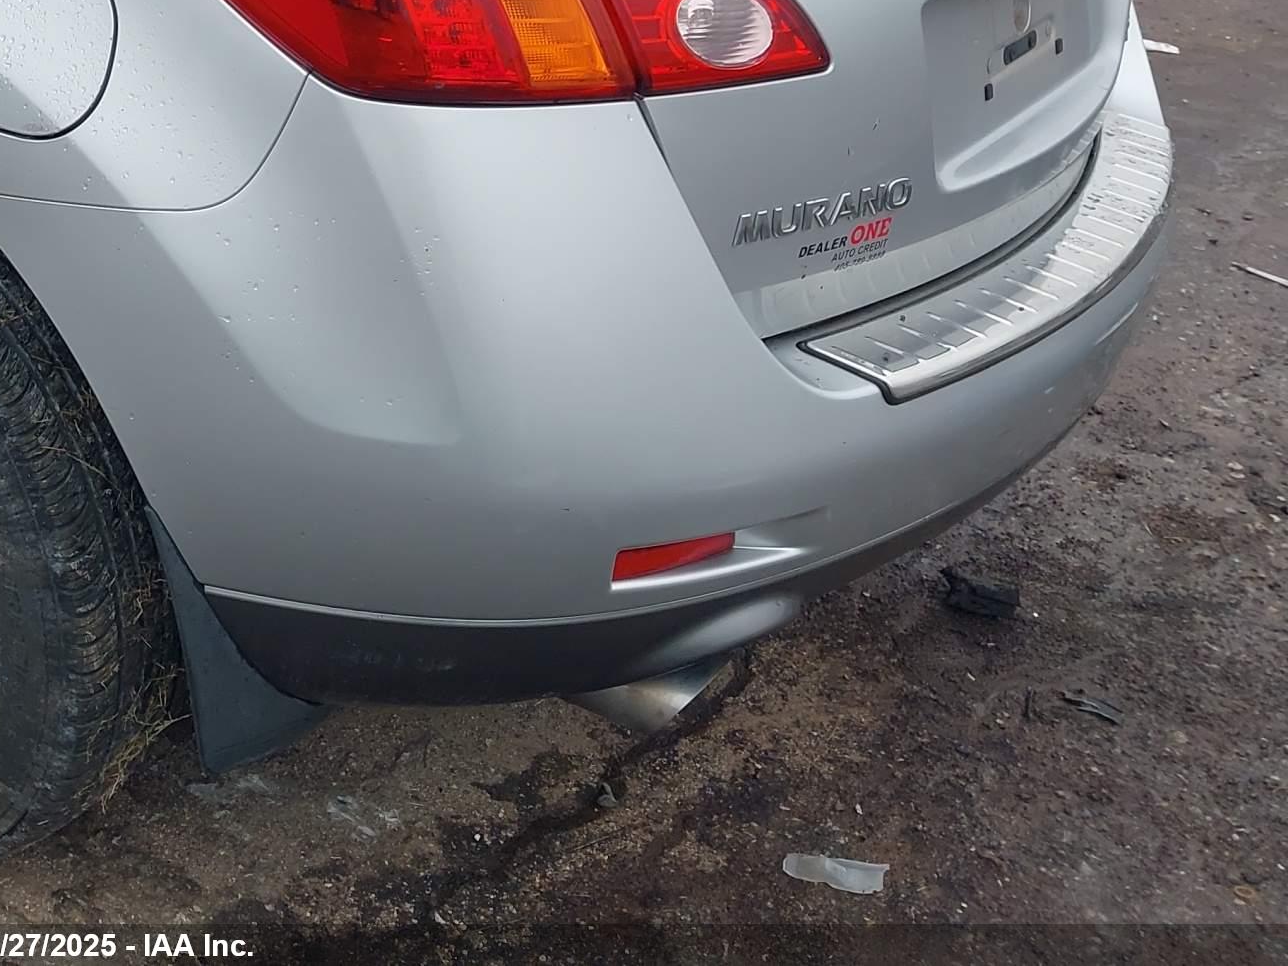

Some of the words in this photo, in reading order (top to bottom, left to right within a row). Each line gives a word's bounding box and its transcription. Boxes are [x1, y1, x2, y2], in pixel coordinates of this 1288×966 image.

[732, 177, 913, 247] MURANO
[798, 235, 848, 259] DEALER
[850, 217, 893, 246] ONE
[831, 249, 856, 263] AUTO
[857, 238, 889, 255] CREDIT
